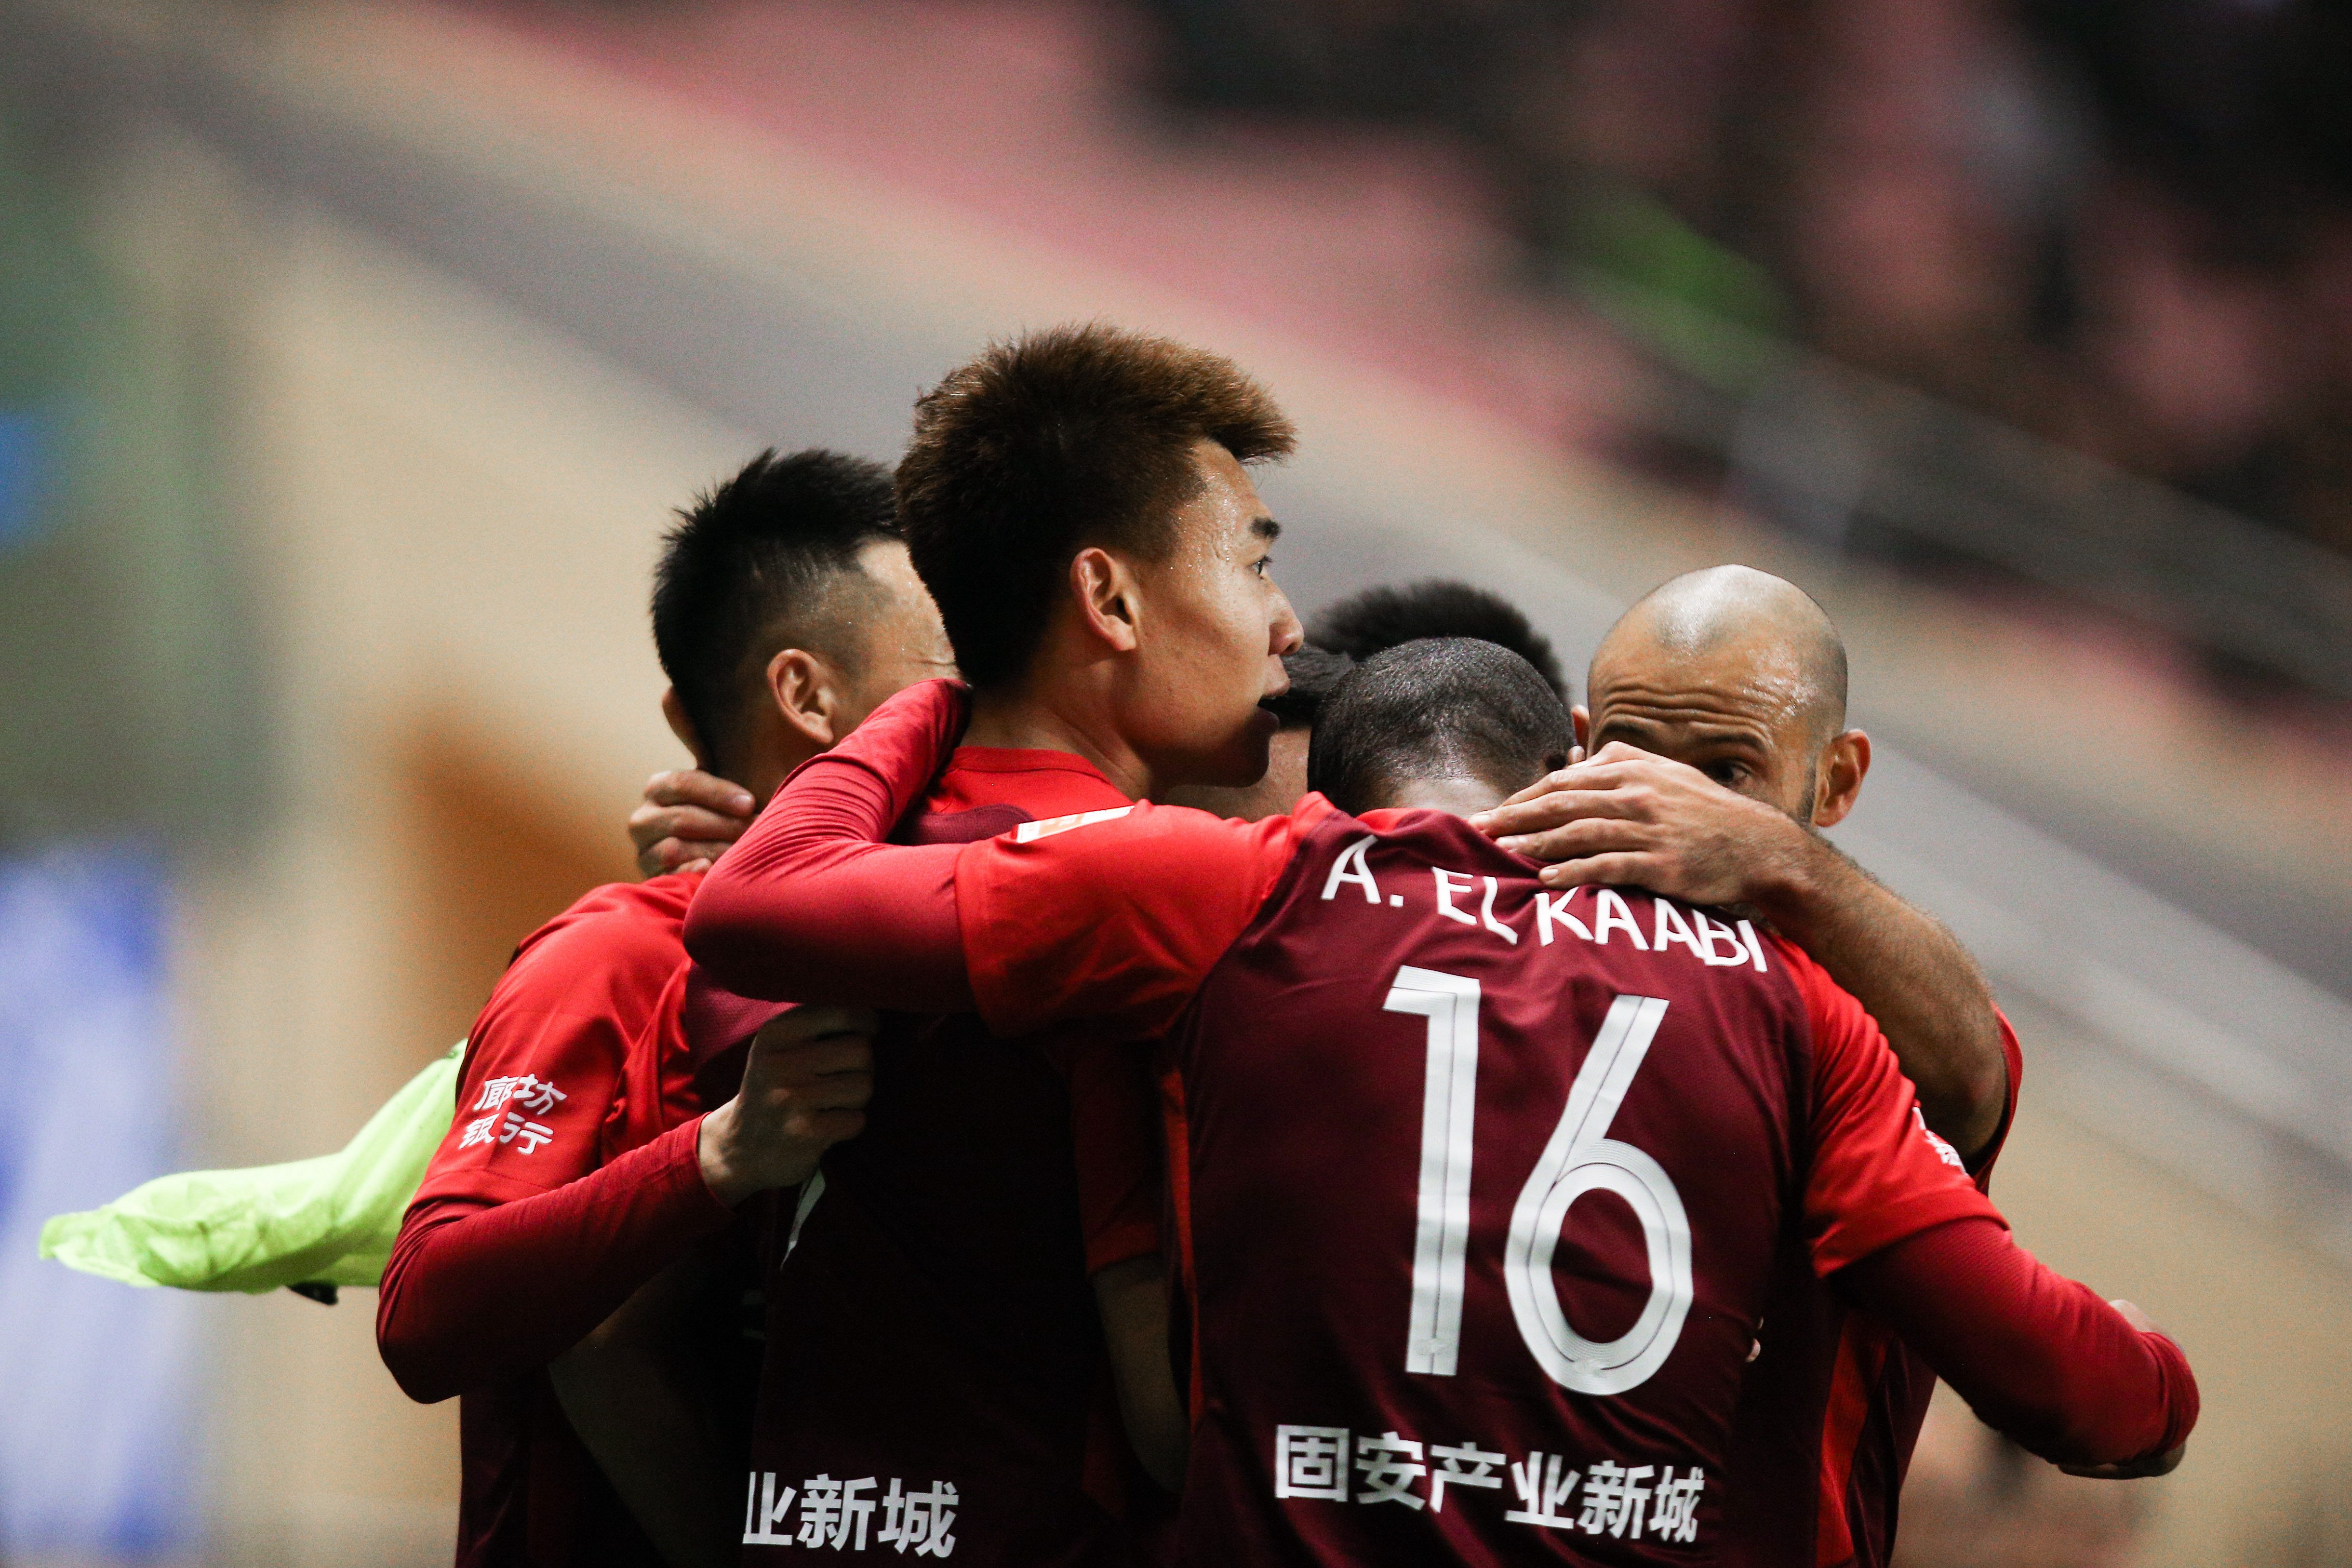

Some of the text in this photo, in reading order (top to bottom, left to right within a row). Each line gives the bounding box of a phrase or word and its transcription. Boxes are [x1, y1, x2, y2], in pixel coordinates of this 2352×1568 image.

[1321, 834, 1768, 972] A. EL KAABI
[459, 1112, 554, 1154] 银行
[473, 1073, 568, 1115] 廊坊
[1382, 965, 1693, 1395] 16
[1275, 1424, 1705, 1543] 固安产业新城
